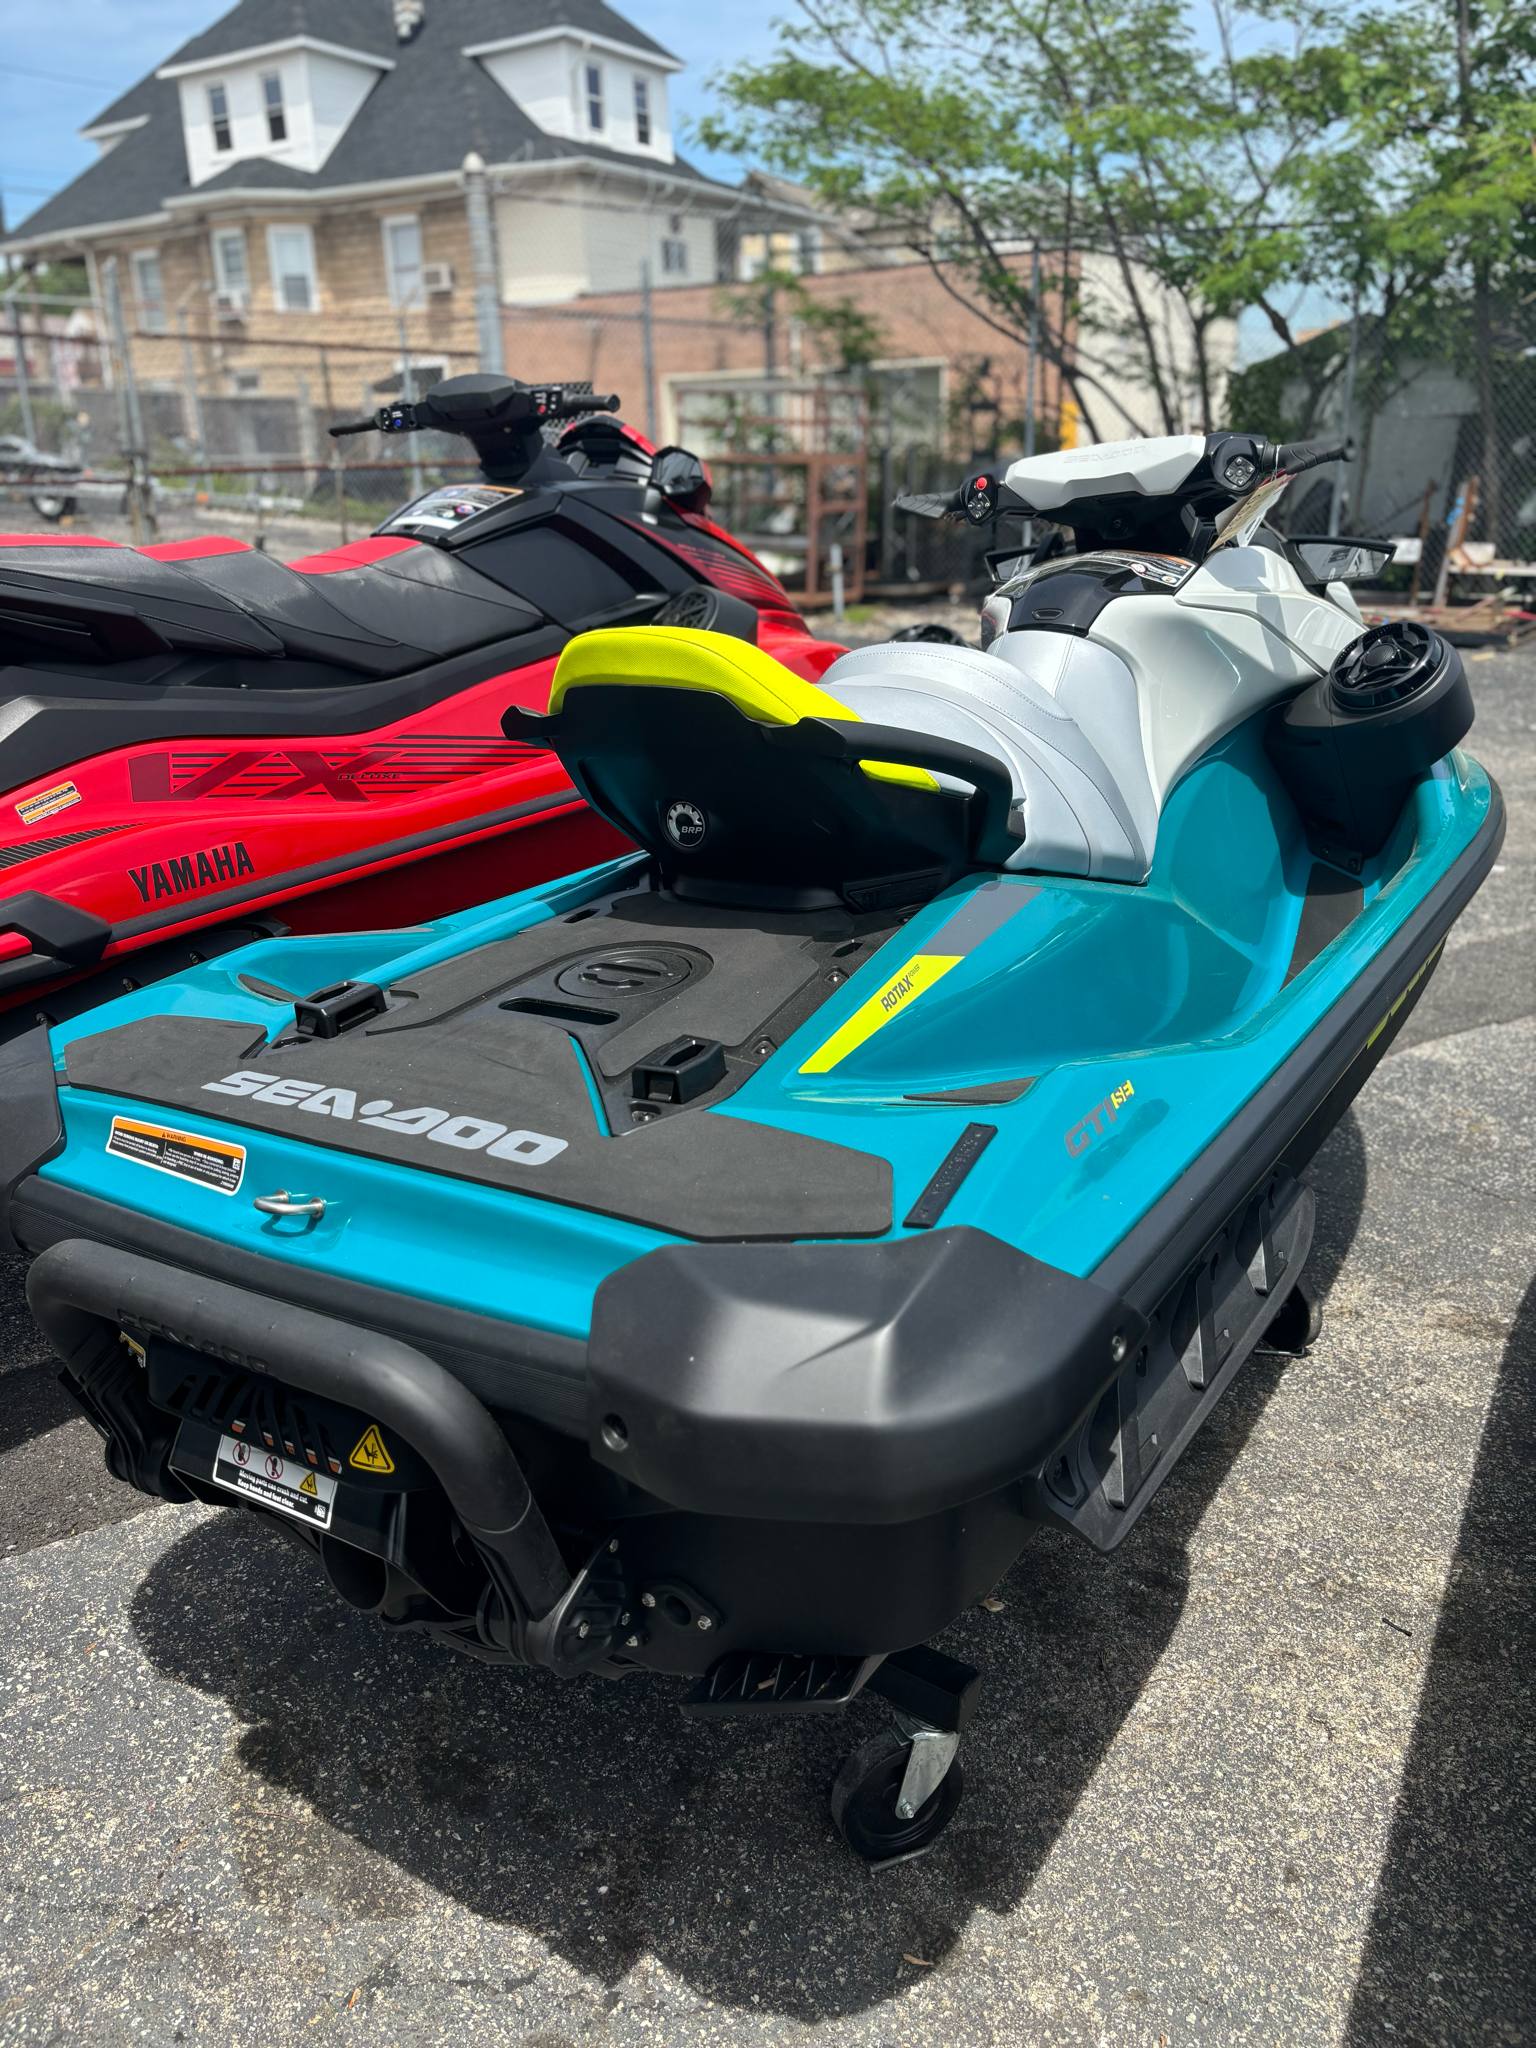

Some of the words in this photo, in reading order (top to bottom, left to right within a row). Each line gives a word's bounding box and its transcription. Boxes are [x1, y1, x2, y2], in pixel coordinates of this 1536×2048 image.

[127, 750, 408, 802] VX
[681, 825, 702, 834] BRP
[128, 841, 255, 903] YAMAHA
[880, 974, 914, 1012] ROTAX
